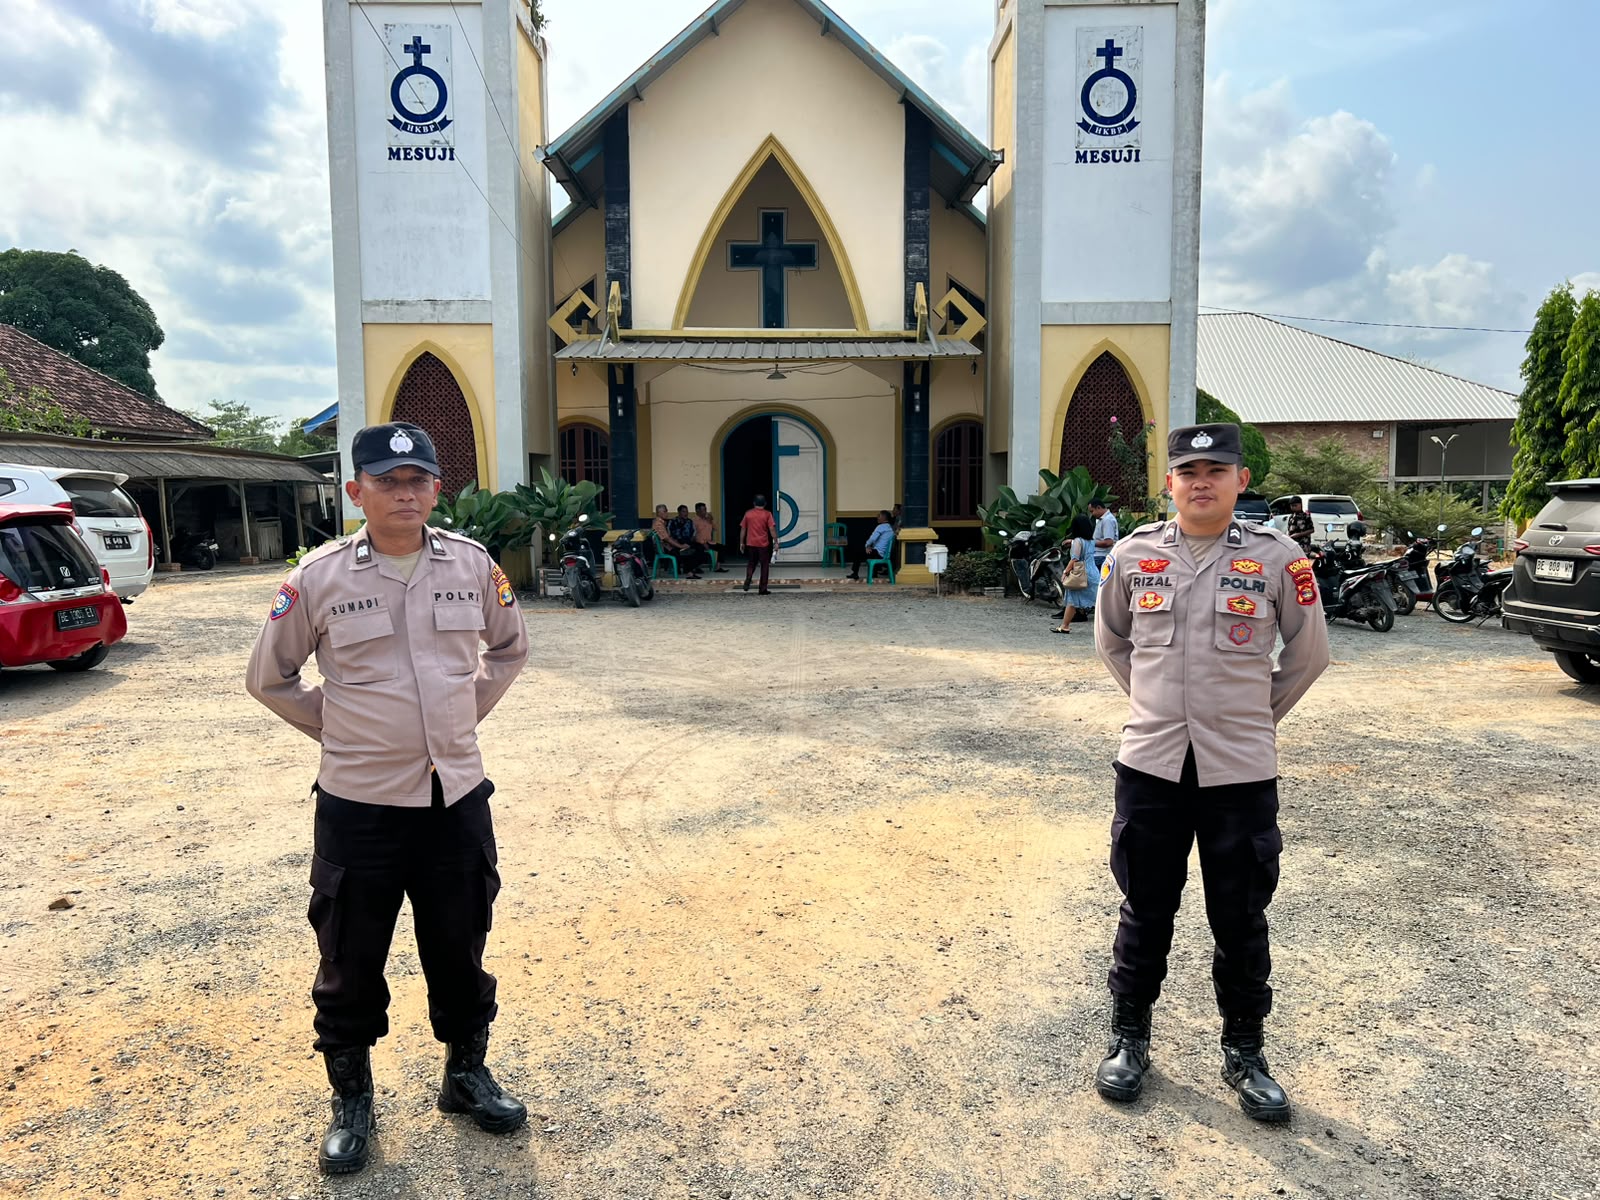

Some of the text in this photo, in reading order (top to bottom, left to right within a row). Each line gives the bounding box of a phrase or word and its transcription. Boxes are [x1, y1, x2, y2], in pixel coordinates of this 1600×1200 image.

[407, 125, 435, 133] HKBP
[1095, 127, 1123, 135] HKBP
[387, 147, 455, 161] MESUJI
[1075, 149, 1141, 163] MESUJI
[1133, 576, 1173, 587] RIZAL
[1220, 576, 1266, 593] POLRI
[434, 591, 480, 602] POLRI
[331, 597, 379, 616] SUMADI
